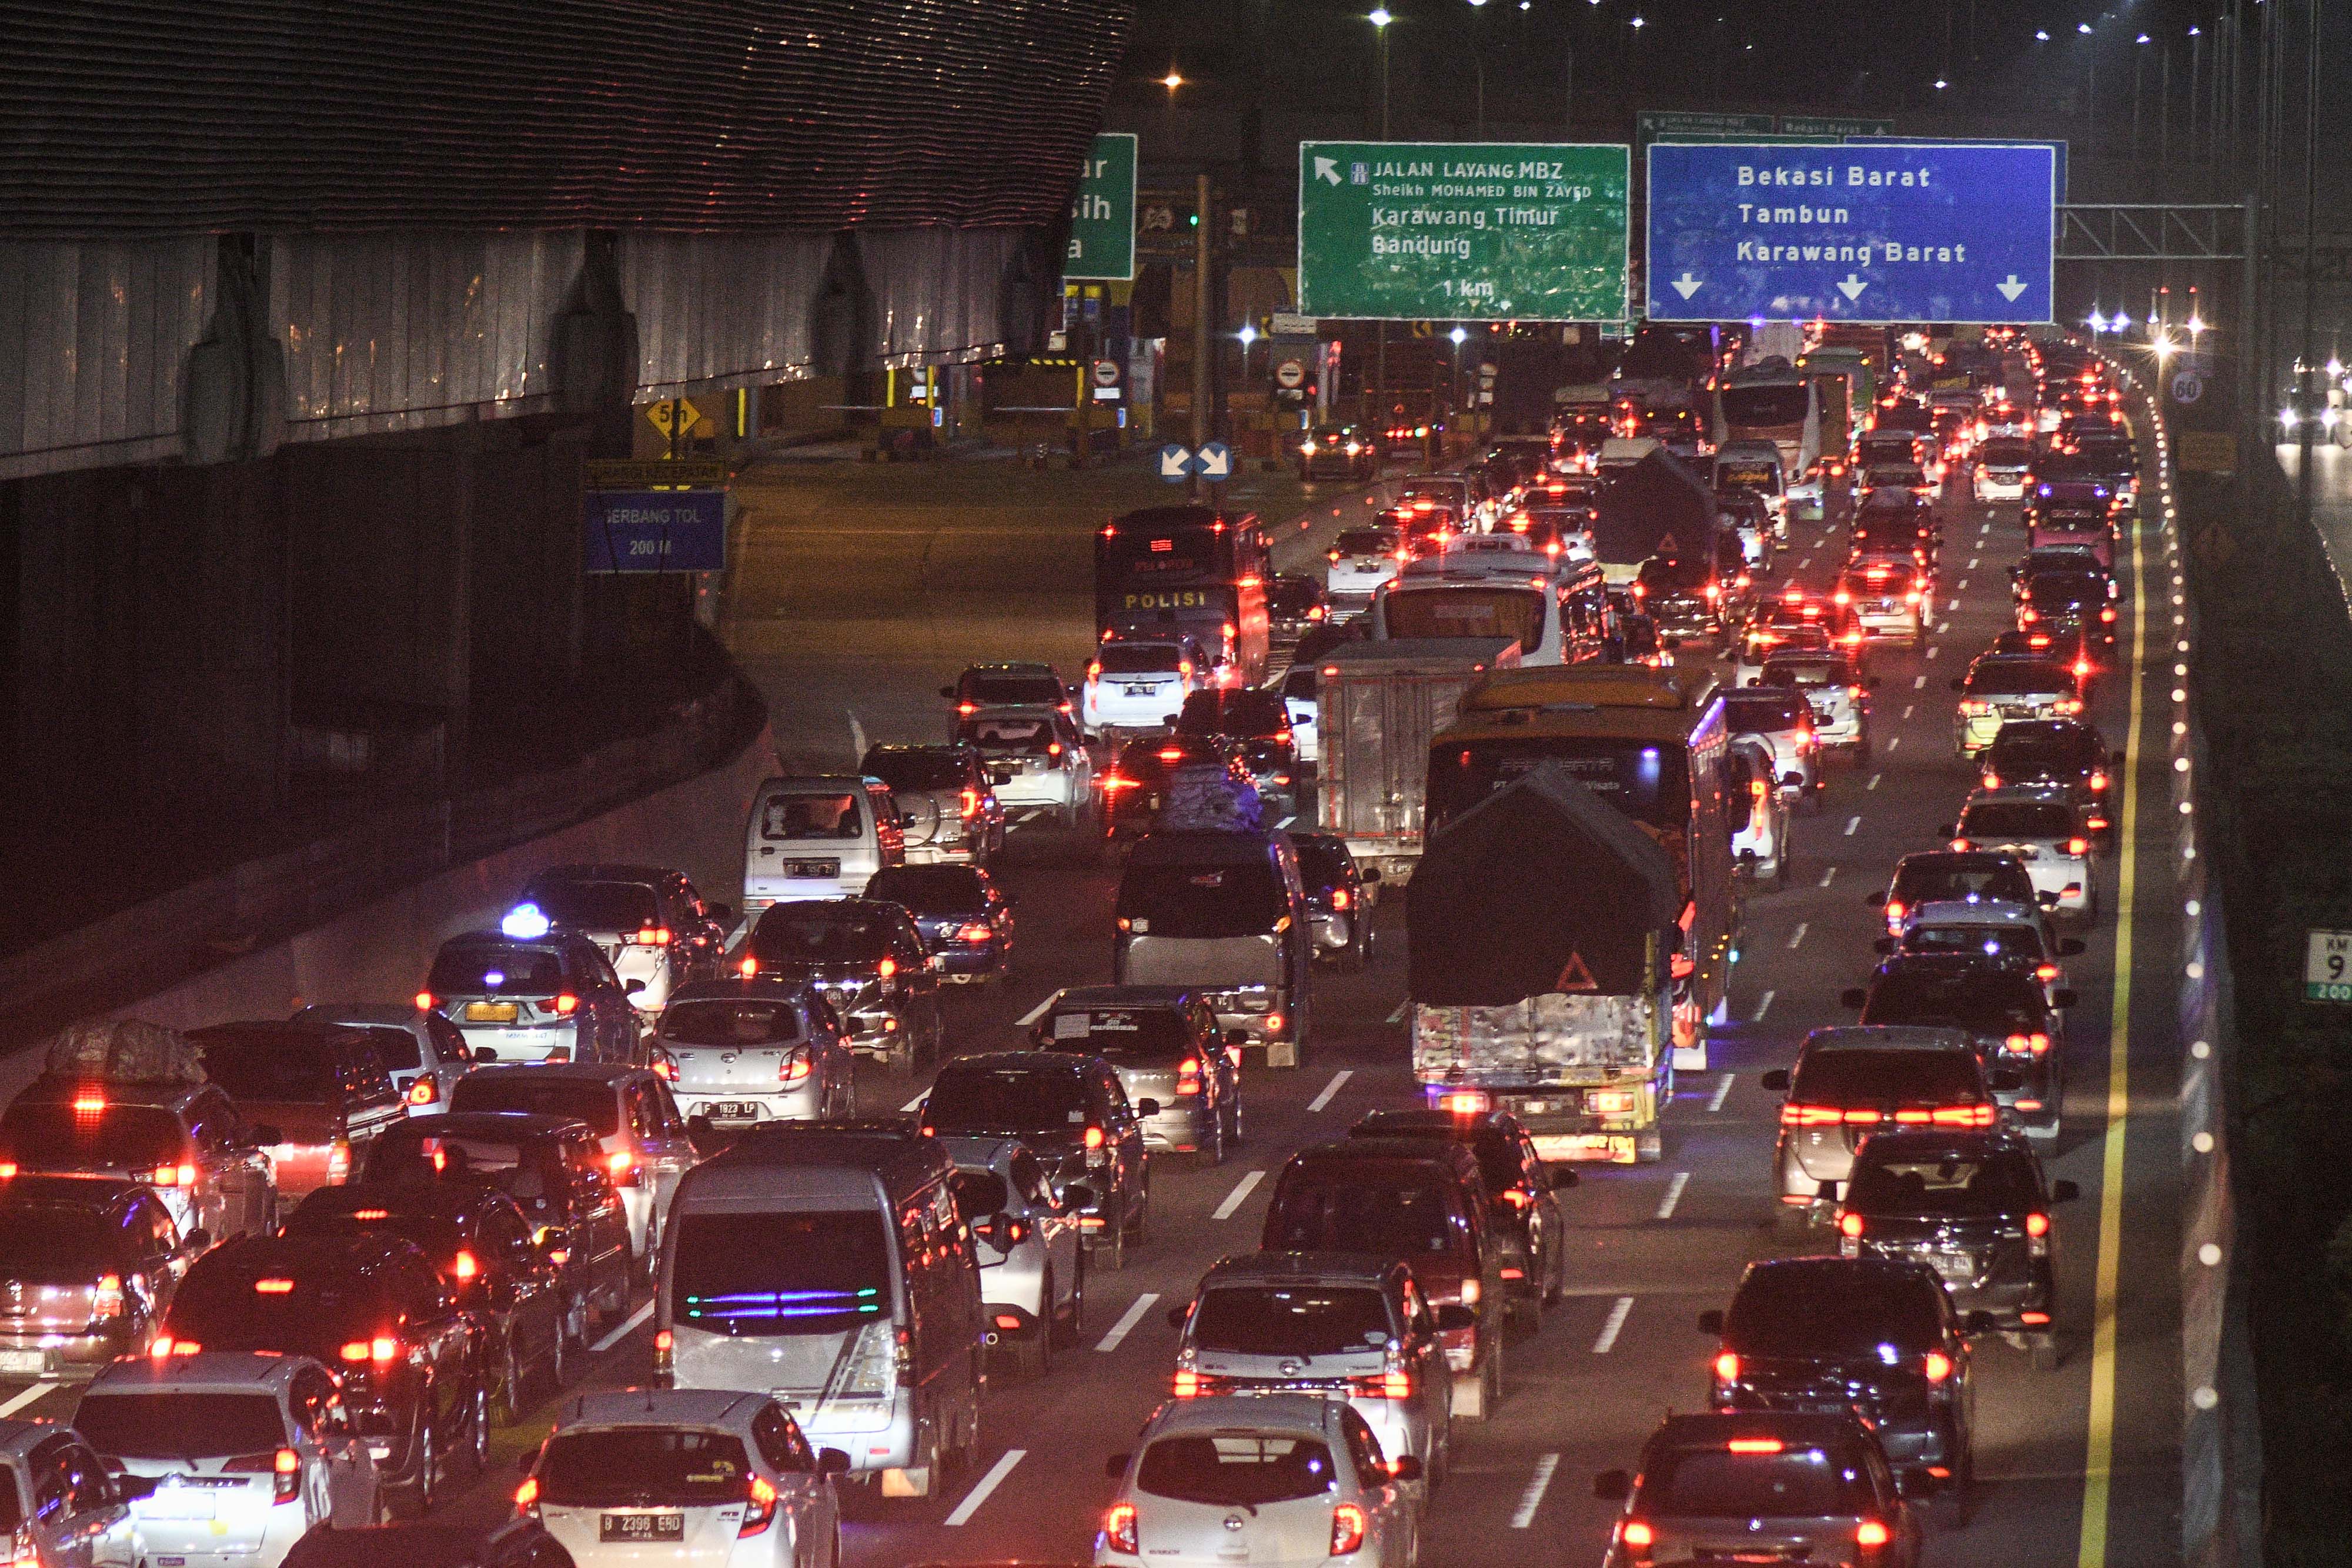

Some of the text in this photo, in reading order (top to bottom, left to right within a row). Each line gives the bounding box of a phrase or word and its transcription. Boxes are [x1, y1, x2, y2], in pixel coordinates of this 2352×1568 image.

[1373, 162, 1564, 179] JALAN LAYANG MBZ
[1738, 166, 1931, 188] Bekasi Barat
[1372, 184, 1592, 199] Sheikh MOHAMED BIN ZAYED
[1372, 207, 1559, 229] Karawang Timur
[1738, 204, 1849, 224] Tambun
[1372, 235, 1471, 259] Bandung
[1736, 242, 1966, 268] Karawang Barat
[1443, 279, 1494, 296] 1 km
[1125, 592, 1205, 609] POLISI
[2328, 955, 2344, 979] 9
[720, 1104, 738, 1114] 1923
[744, 1104, 754, 1114] LP
[622, 1516, 651, 1532] 2396
